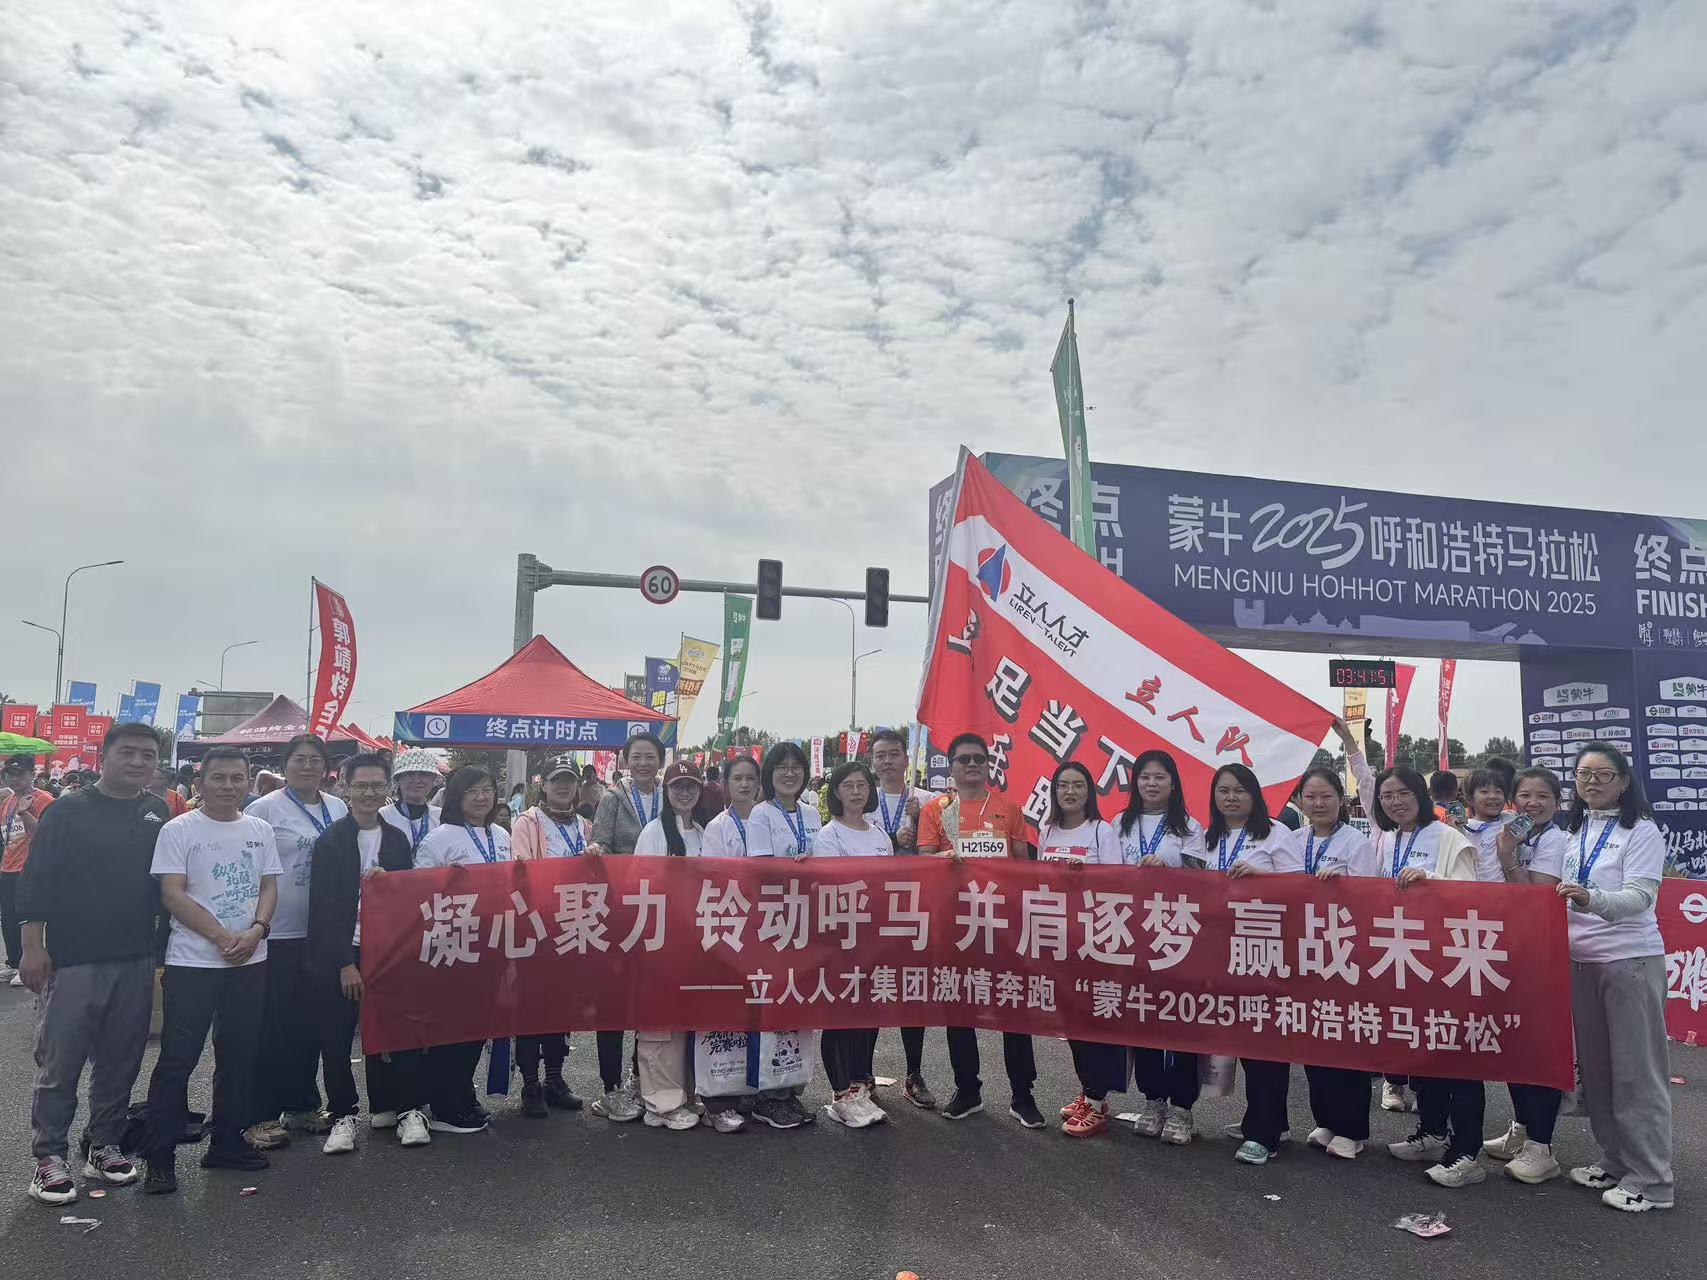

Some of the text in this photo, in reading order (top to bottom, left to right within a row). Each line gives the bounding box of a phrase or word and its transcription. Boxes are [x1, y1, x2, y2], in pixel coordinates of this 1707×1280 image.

[1633, 533, 1707, 585] 终点
[648, 575, 672, 595] 60
[1174, 563, 1597, 616] MENGNIU HOHHOT MARATHON 2025
[1012, 582, 1090, 649] 立人人才
[1570, 687, 1596, 702] 蒙牛
[1685, 681, 1707, 699] 蒙牛
[485, 716, 599, 742] 终点计时点
[1124, 674, 1254, 768] 立人队
[678, 763, 688, 774] LA
[961, 841, 1005, 854] H21569
[418, 878, 1512, 997] 凝心聚力 铃动呼马 并肩逐梦 赢战未来
